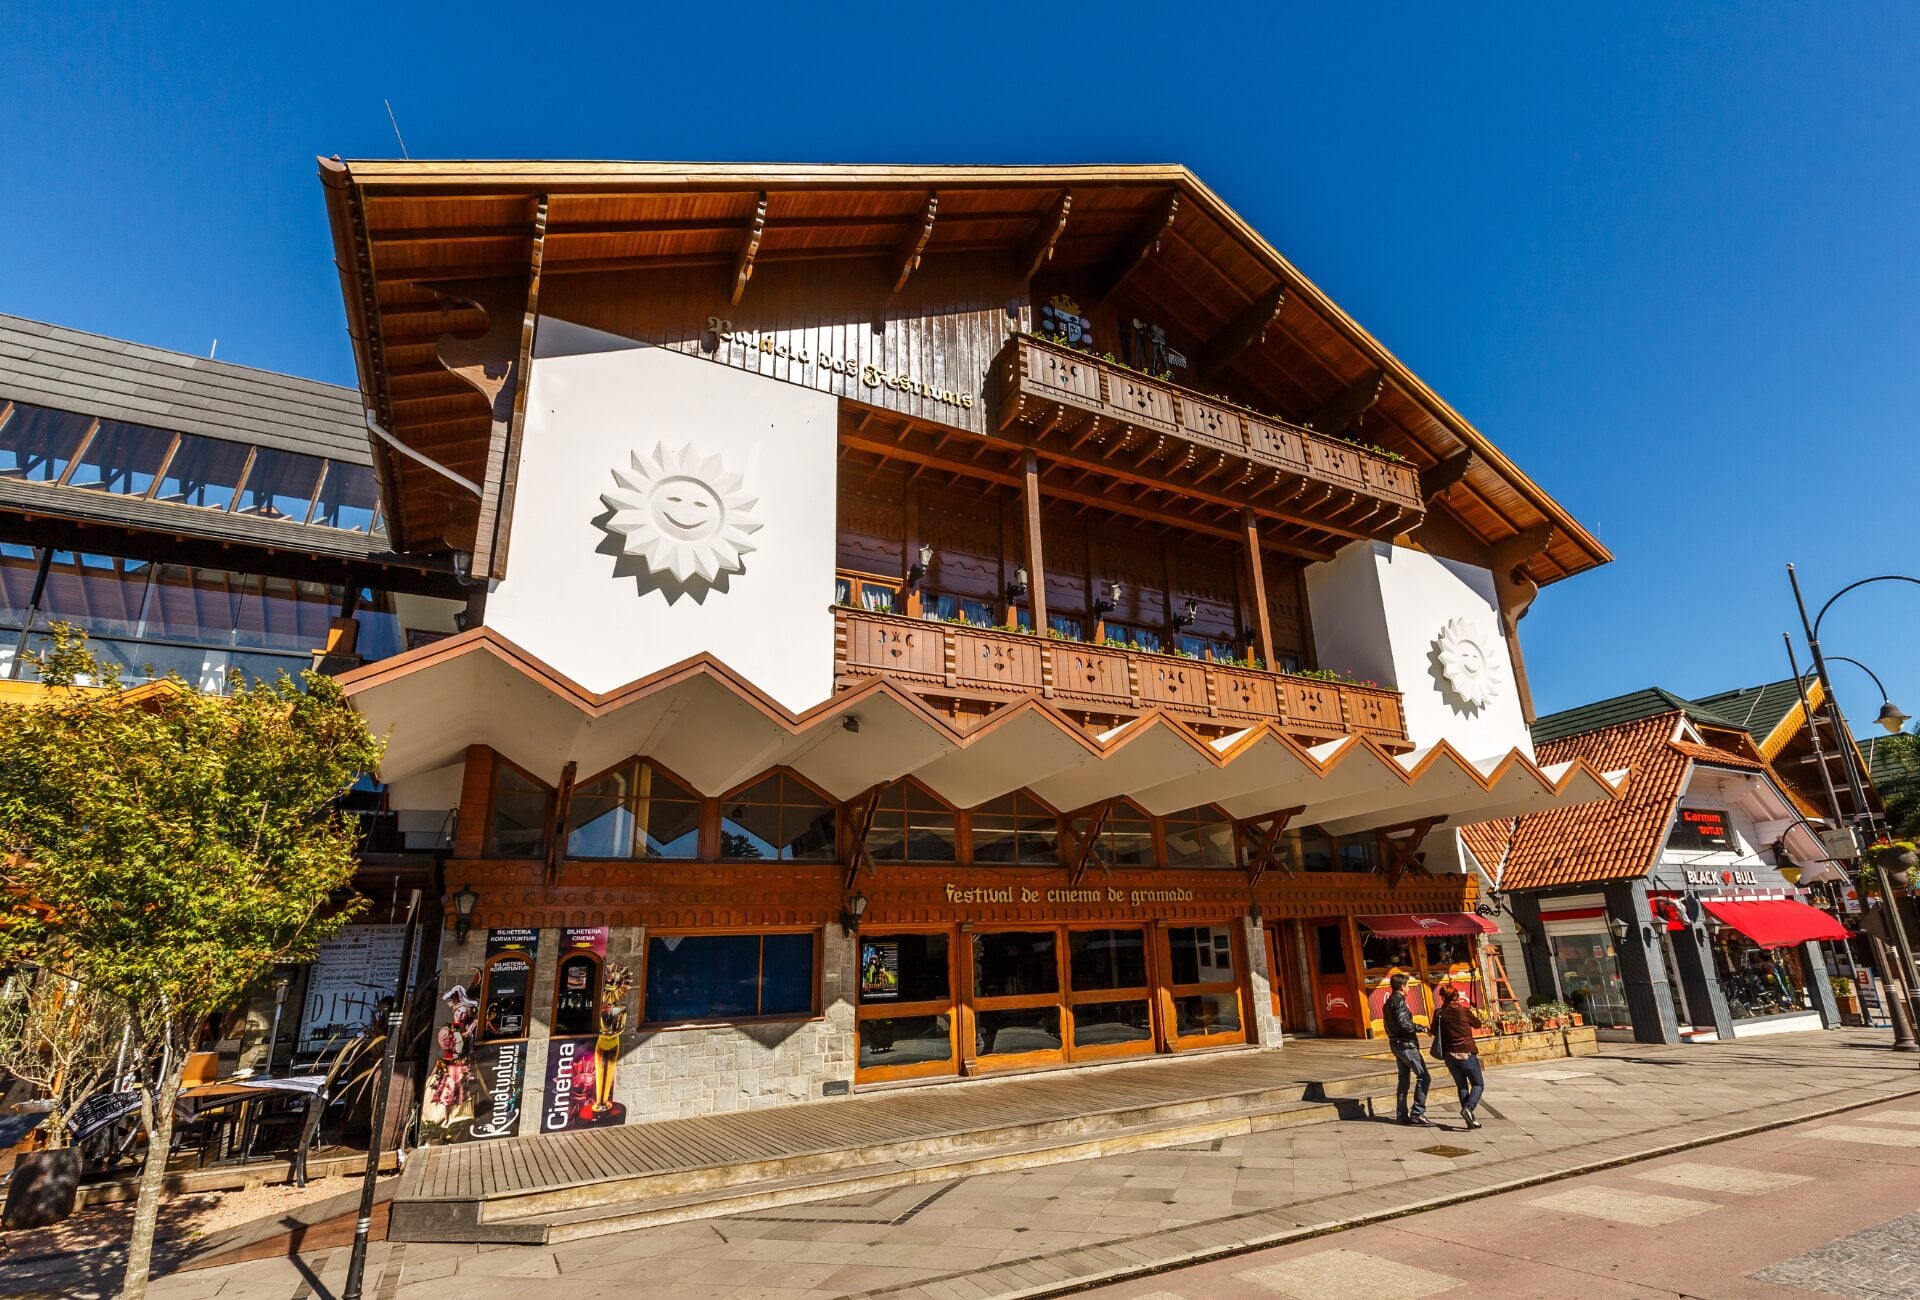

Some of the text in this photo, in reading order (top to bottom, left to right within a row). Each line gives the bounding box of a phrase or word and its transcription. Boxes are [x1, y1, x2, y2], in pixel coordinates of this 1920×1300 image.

[819, 351, 858, 377] dos
[862, 363, 974, 410] Festivais
[946, 883, 1193, 906] Festival de cinema de gramado
[1686, 870, 1759, 885] BLACK BULL
[470, 1045, 520, 1138] Korvatunturi
[547, 1043, 576, 1130] Cinema
